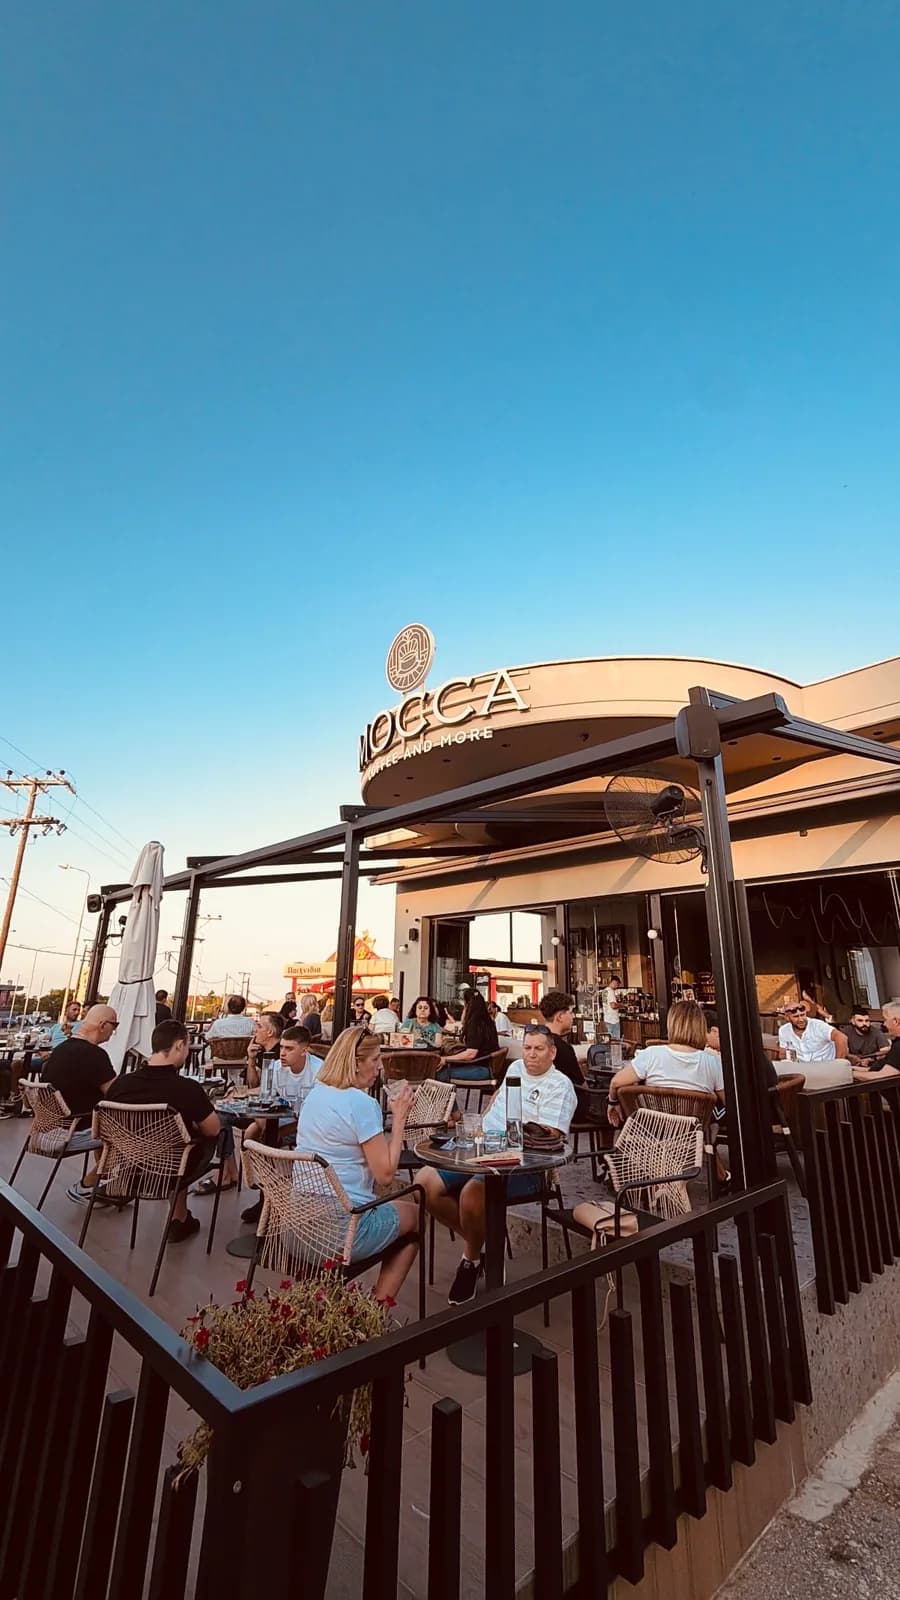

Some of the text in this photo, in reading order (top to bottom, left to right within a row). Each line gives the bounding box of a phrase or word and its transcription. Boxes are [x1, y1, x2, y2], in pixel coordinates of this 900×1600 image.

[357, 670, 530, 773] MOCCA
[403, 741, 433, 760] AND
[440, 727, 494, 747] MORE
